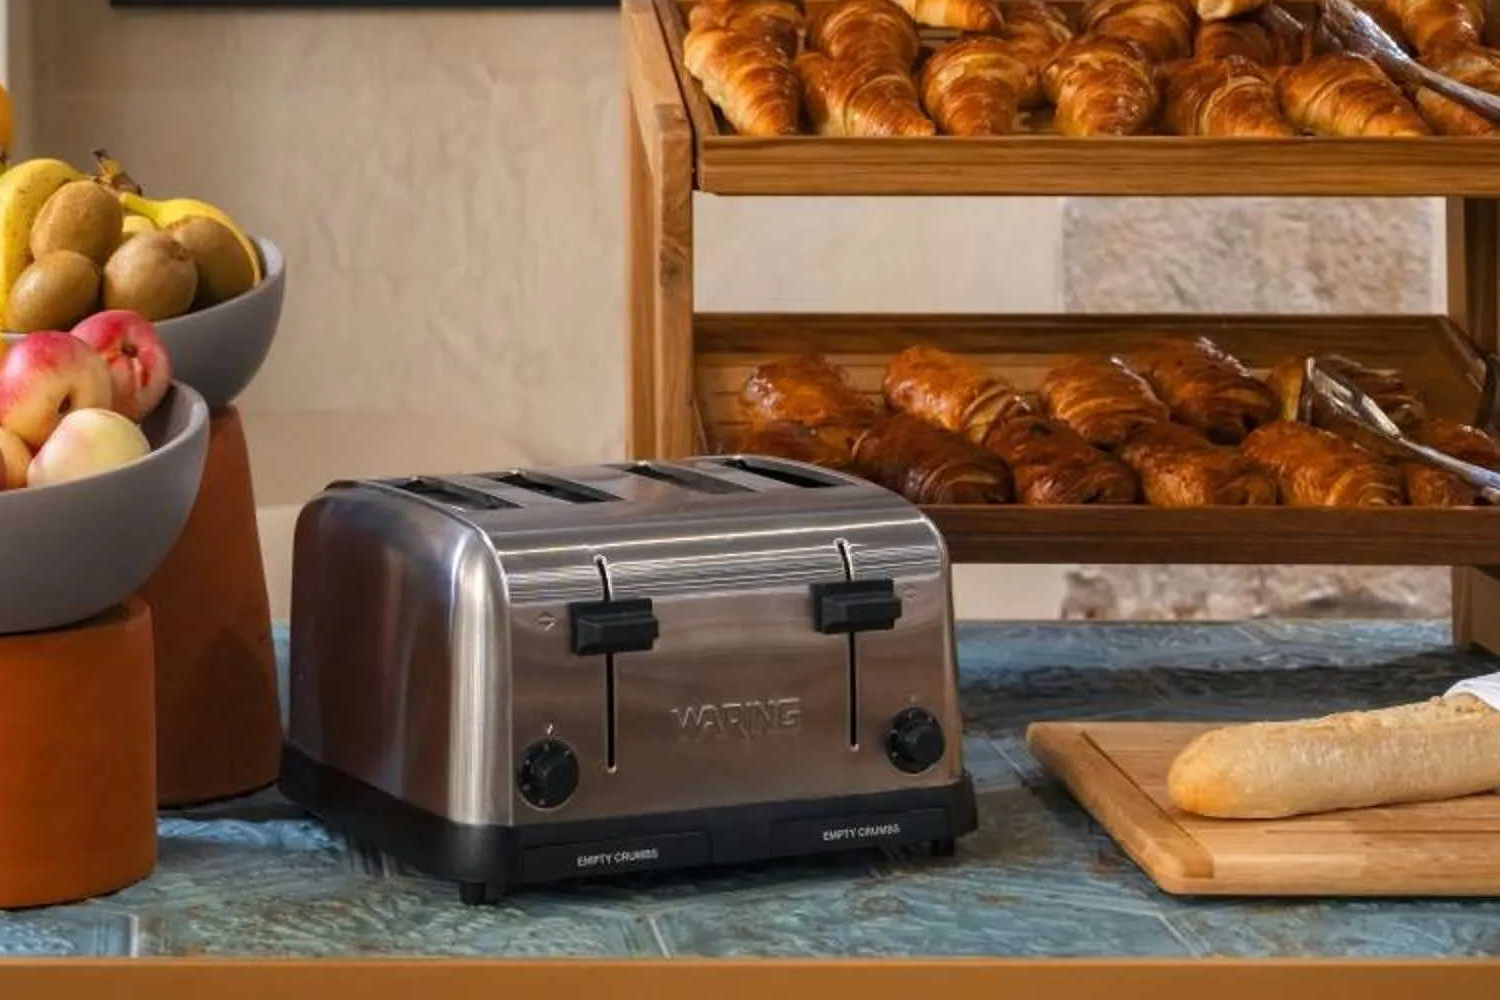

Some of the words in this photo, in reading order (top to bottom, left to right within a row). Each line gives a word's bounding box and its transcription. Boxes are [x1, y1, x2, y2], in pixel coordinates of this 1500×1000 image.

[669, 697, 801, 744] WARING
[822, 828, 856, 841] EMPTY
[858, 823, 901, 838] CRUMBS
[577, 853, 613, 867] EMPTY
[613, 848, 659, 863] CRUMBS
